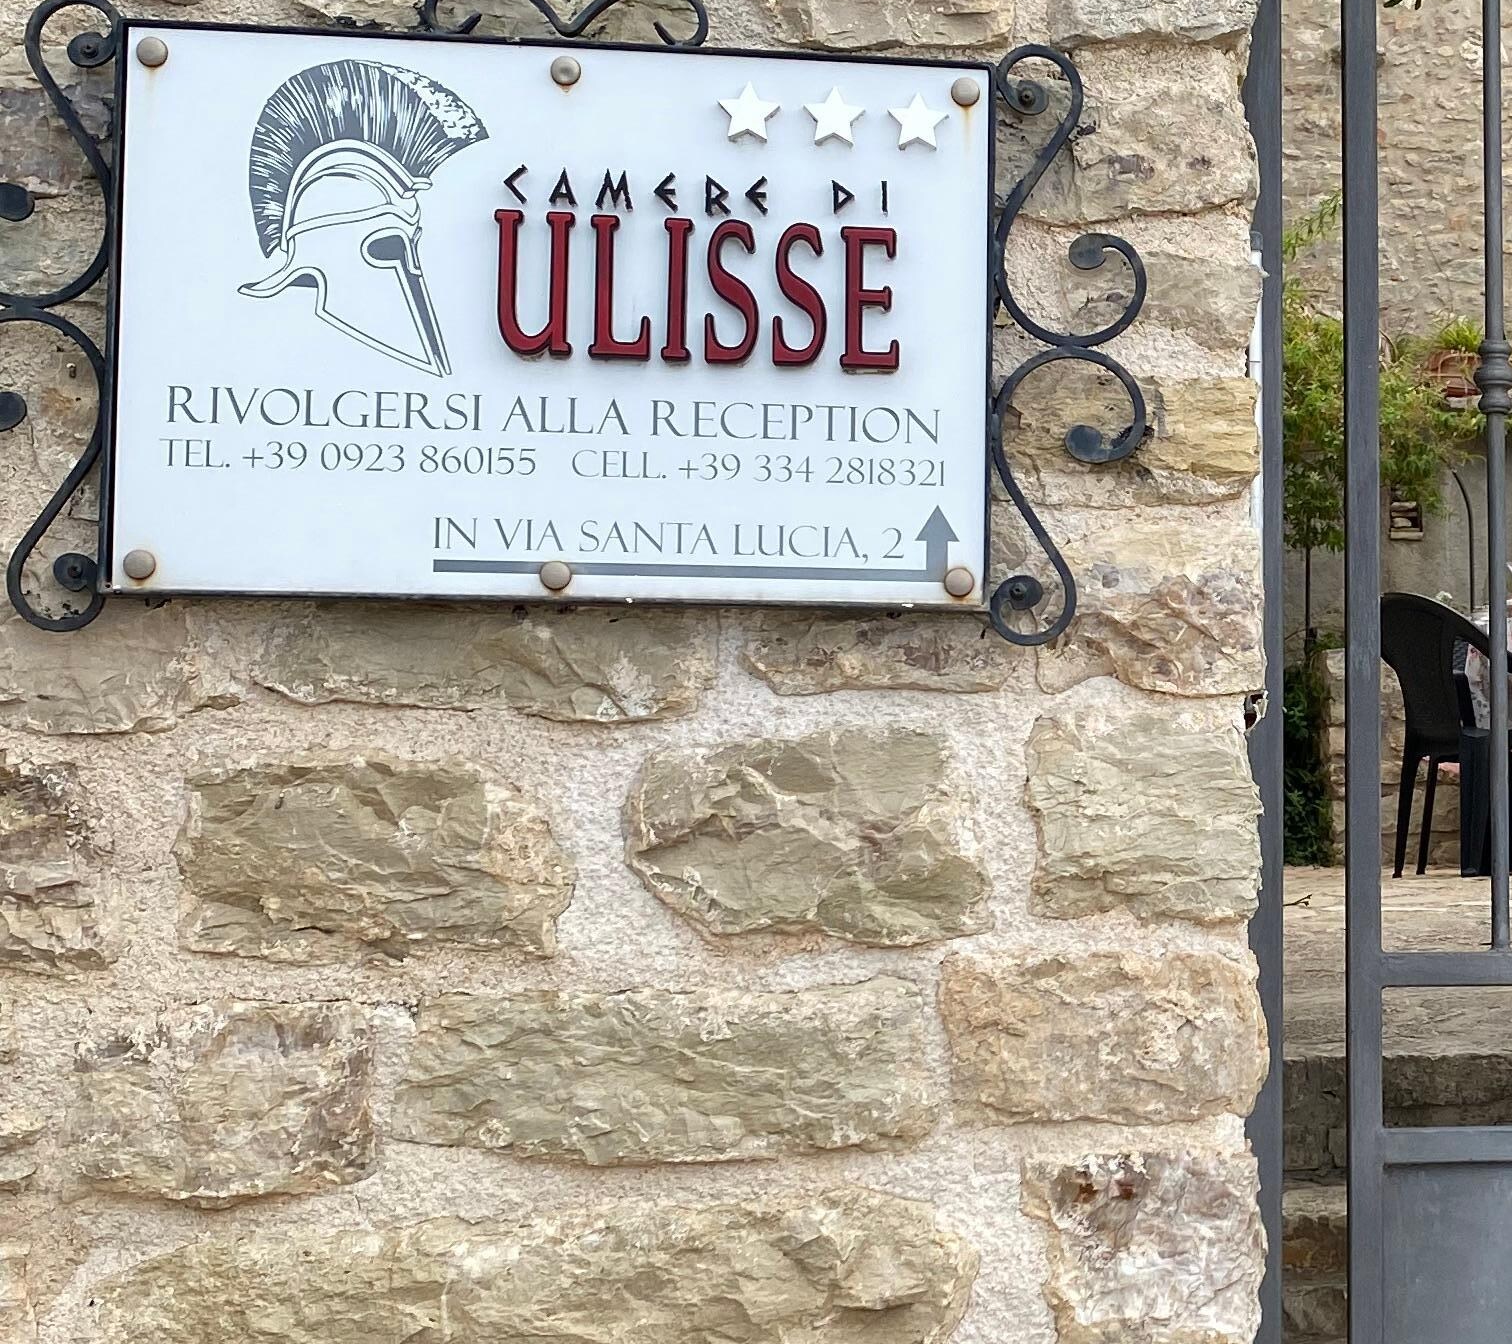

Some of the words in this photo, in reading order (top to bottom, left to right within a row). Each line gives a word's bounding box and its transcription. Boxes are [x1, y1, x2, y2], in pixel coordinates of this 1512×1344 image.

[502, 164, 769, 217] CAMERE
[831, 180, 889, 218] DI
[494, 209, 900, 372] ULISSE
[167, 385, 483, 432] RIVOLGERSI
[501, 395, 631, 436] ALLA
[649, 399, 941, 445] RECEPTION
[160, 438, 231, 468] TEL.
[241, 441, 308, 470] +39
[320, 442, 405, 473] 0923
[419, 444, 537, 476] 860155
[571, 449, 667, 479] CELL.
[678, 452, 741, 481] +39
[753, 454, 814, 483] 334
[825, 456, 945, 487] 2818321
[433, 516, 478, 550] IN
[493, 517, 565, 552] VIA
[578, 519, 719, 555] SANTA
[733, 523, 869, 564] LUCIA,
[881, 527, 904, 559] 2
